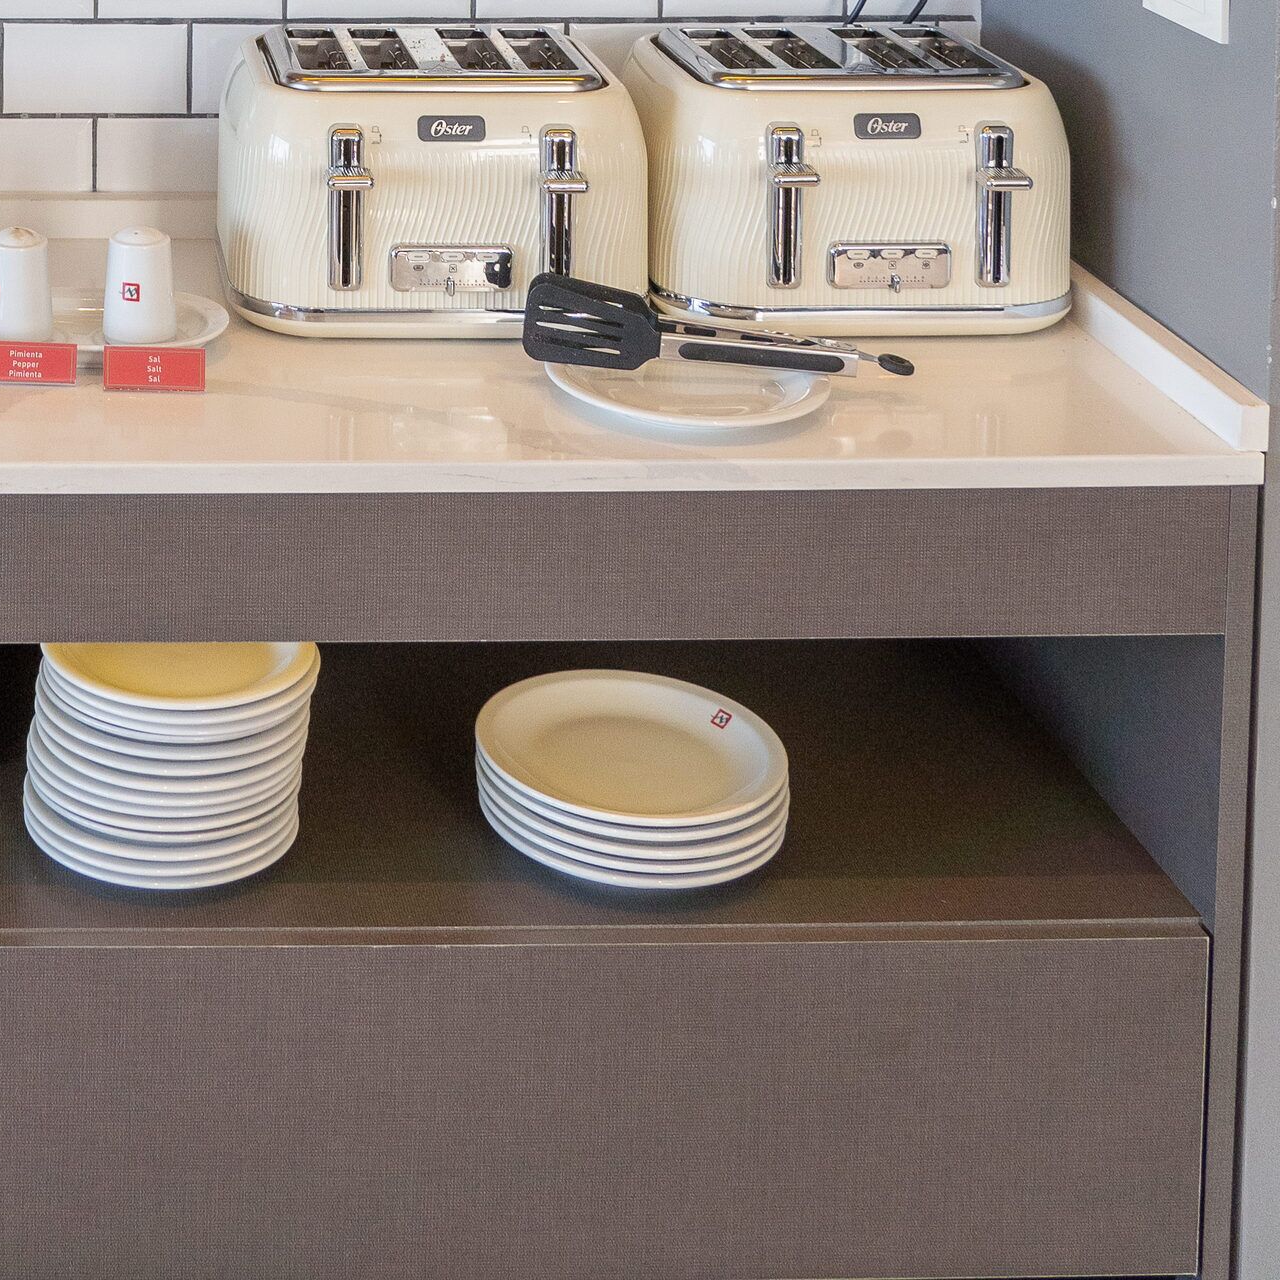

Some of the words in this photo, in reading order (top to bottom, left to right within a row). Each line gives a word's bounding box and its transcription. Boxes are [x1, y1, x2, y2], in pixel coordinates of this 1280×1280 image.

[430, 119, 473, 137] Oster
[867, 117, 908, 134] Oster
[9, 350, 43, 358] Pimienta
[148, 355, 161, 363] Sal
[12, 360, 39, 369] Pepper
[147, 365, 162, 373] Salt
[9, 369, 42, 378] Pimienta
